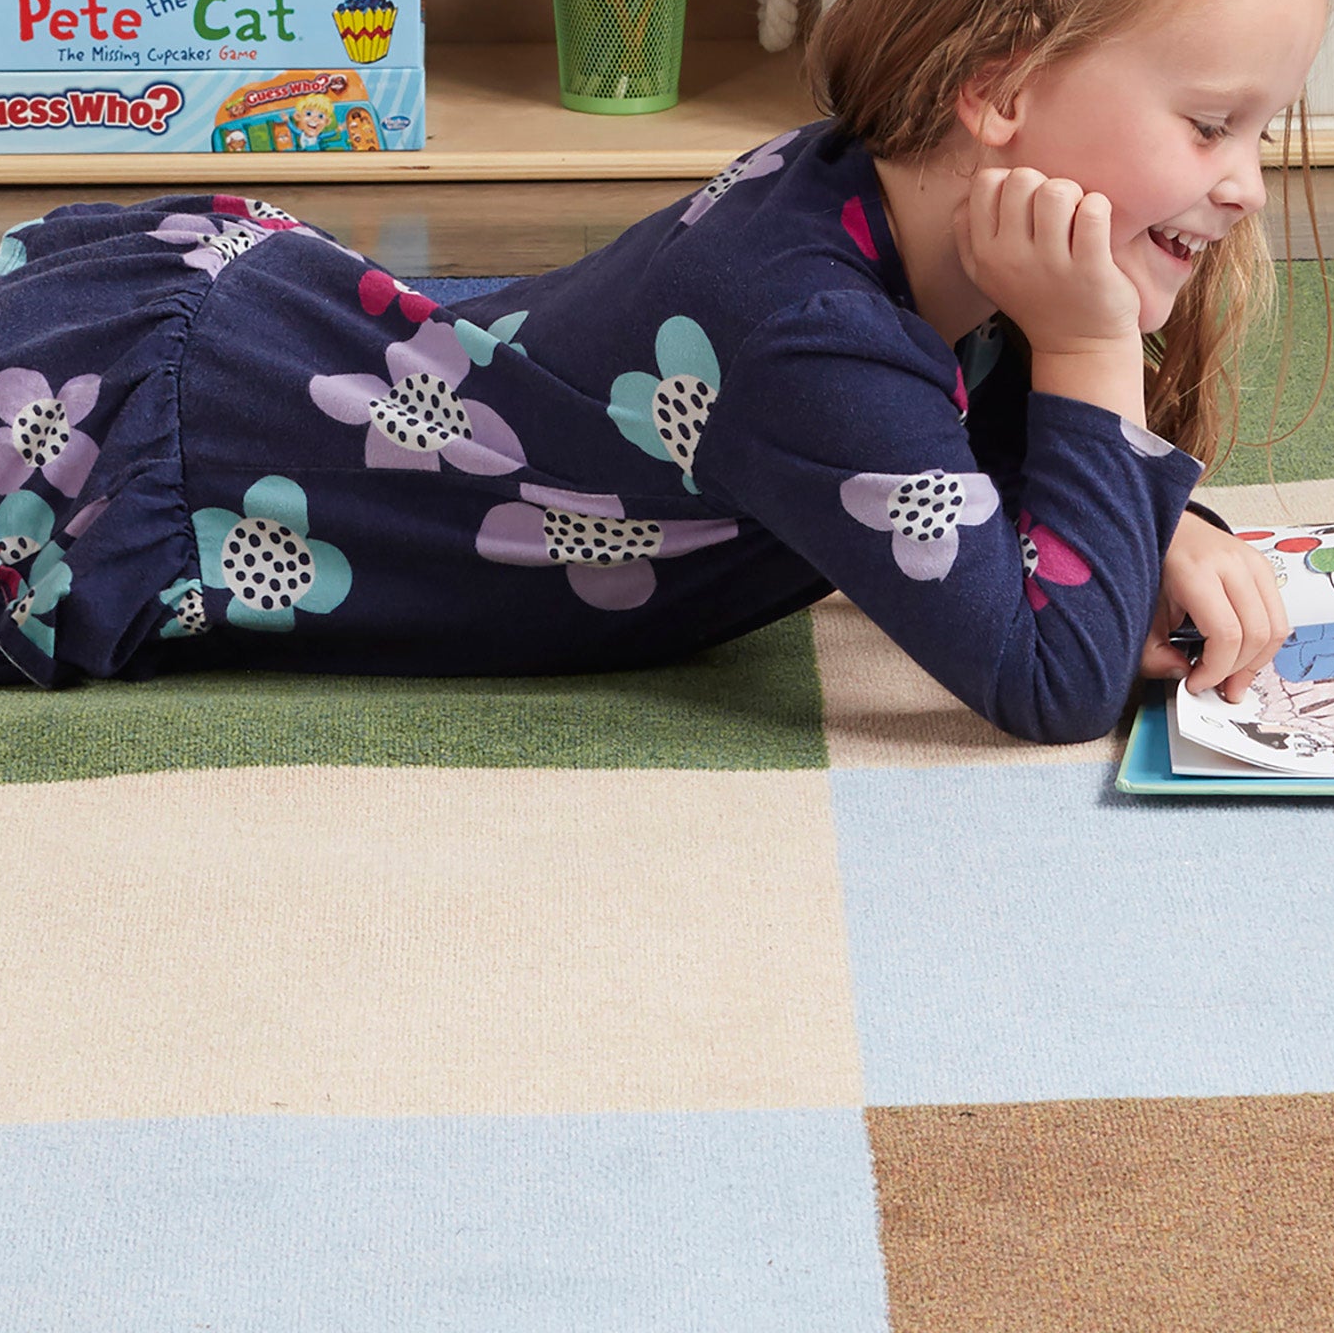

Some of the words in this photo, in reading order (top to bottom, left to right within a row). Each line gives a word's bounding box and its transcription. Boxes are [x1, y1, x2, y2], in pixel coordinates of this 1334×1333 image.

[58, 47, 85, 62] The
[92, 45, 140, 66] Missing
[147, 46, 212, 66] Cupcakes
[219, 45, 257, 61] Game
[245, 86, 289, 106] Guess
[289, 74, 331, 95] Who?
[69, 85, 182, 132] Who?
